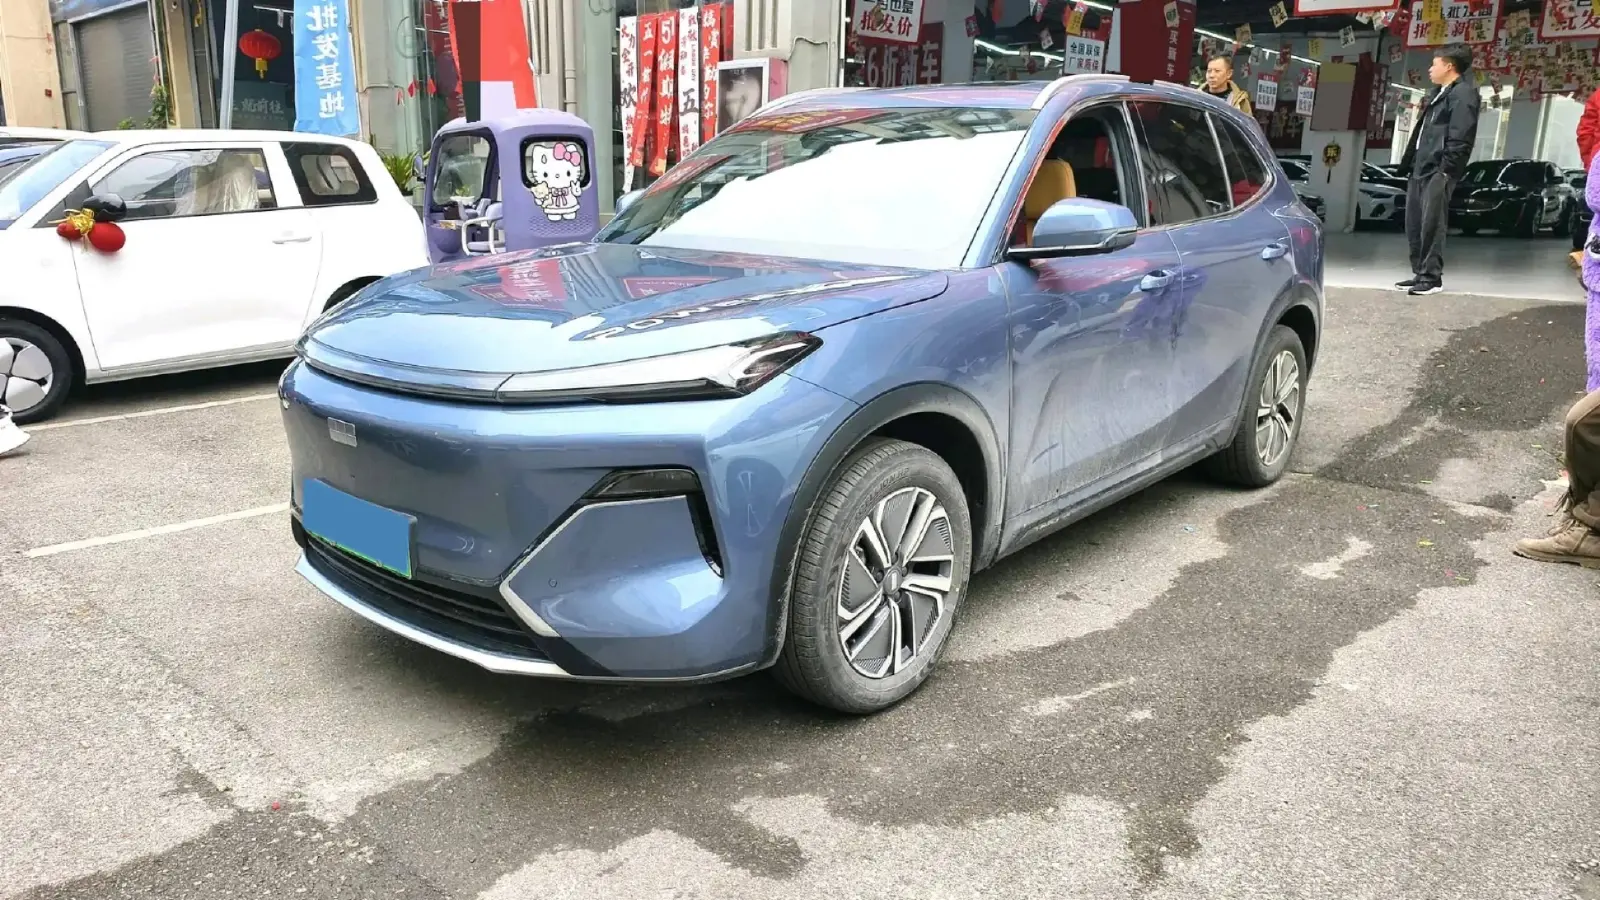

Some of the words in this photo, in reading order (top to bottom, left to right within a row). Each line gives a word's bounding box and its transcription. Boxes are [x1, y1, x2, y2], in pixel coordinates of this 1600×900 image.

[863, 0, 914, 14] 也是
[860, 11, 913, 37] 批发价
[1070, 41, 1101, 57] 全国联保
[867, 41, 939, 88] 6折新车
[680, 88, 699, 116] 五
